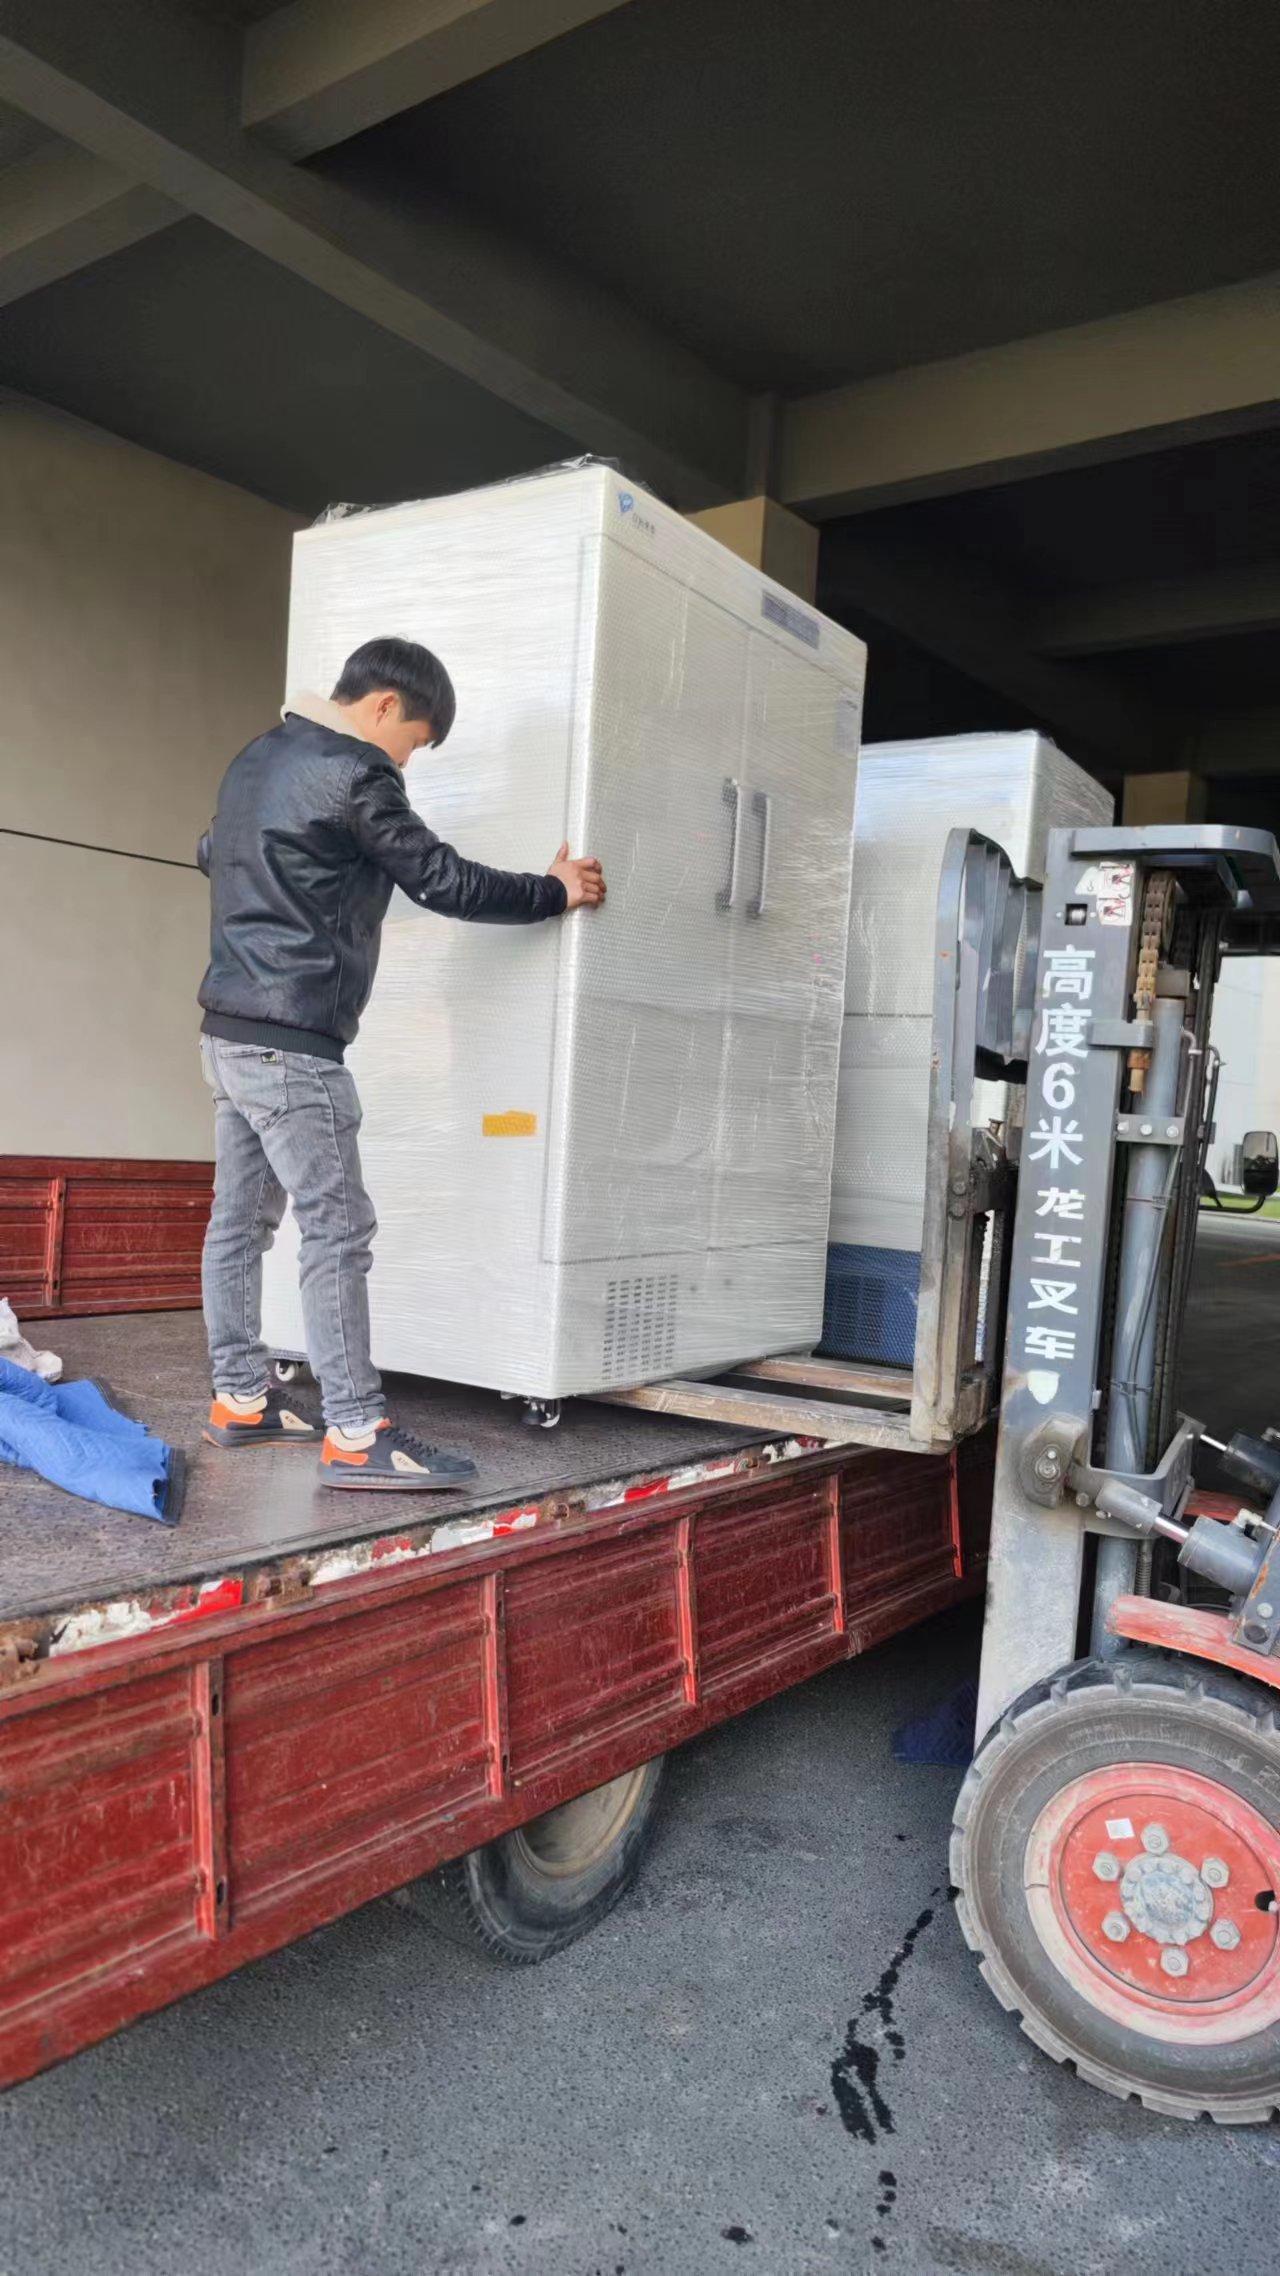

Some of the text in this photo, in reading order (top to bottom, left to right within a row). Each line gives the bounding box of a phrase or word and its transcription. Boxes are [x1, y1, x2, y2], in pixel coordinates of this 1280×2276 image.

[1028, 944, 1096, 1169] 高度6米
[1024, 1187, 1086, 1359] 龙工叉车
